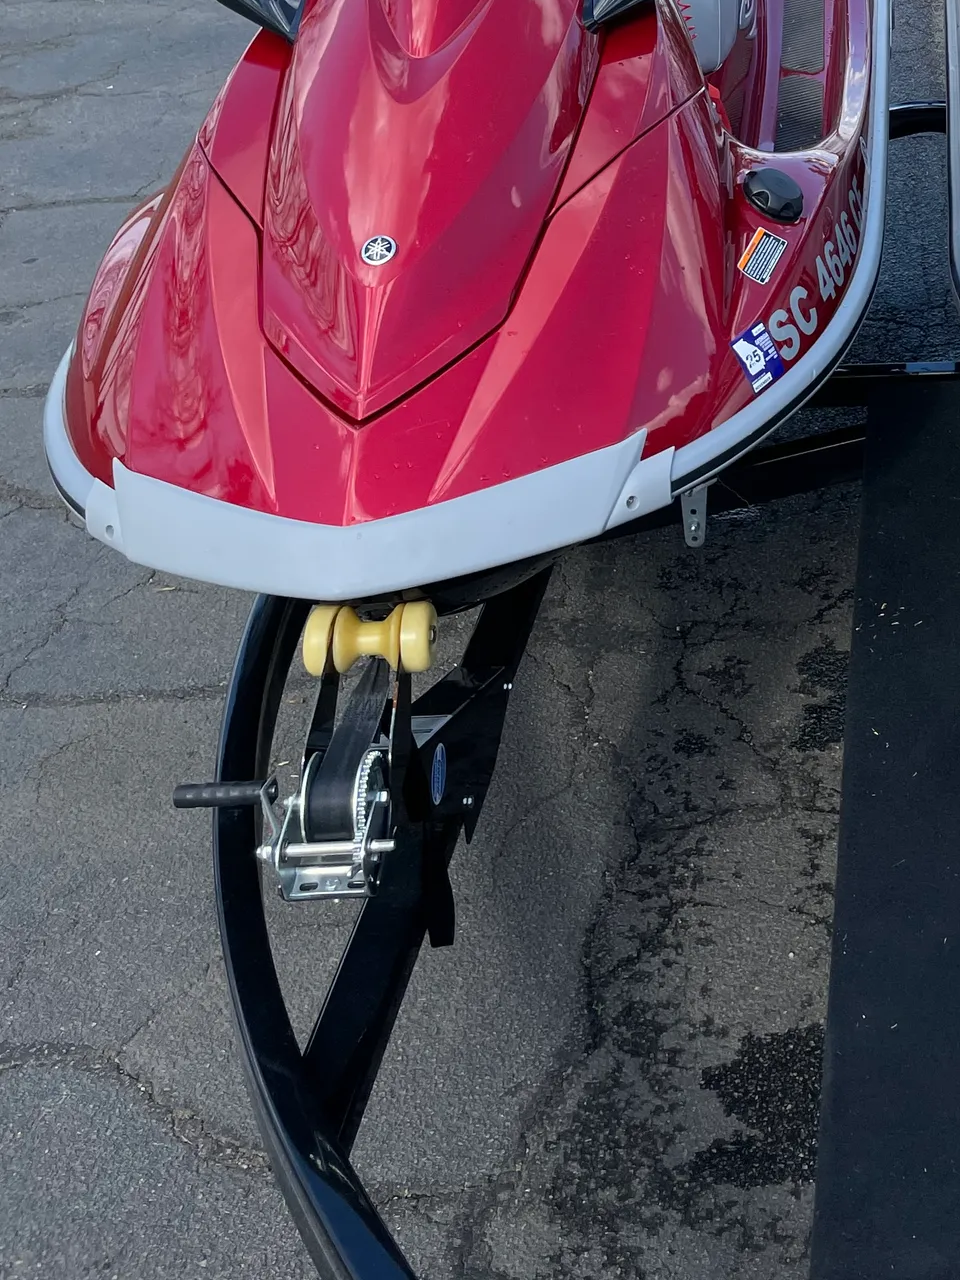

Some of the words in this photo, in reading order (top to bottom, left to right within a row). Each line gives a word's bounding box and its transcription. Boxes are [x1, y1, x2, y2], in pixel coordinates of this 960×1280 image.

[768, 285, 818, 361] SC
[815, 210, 858, 303] 4646
[745, 349, 762, 369] 25
